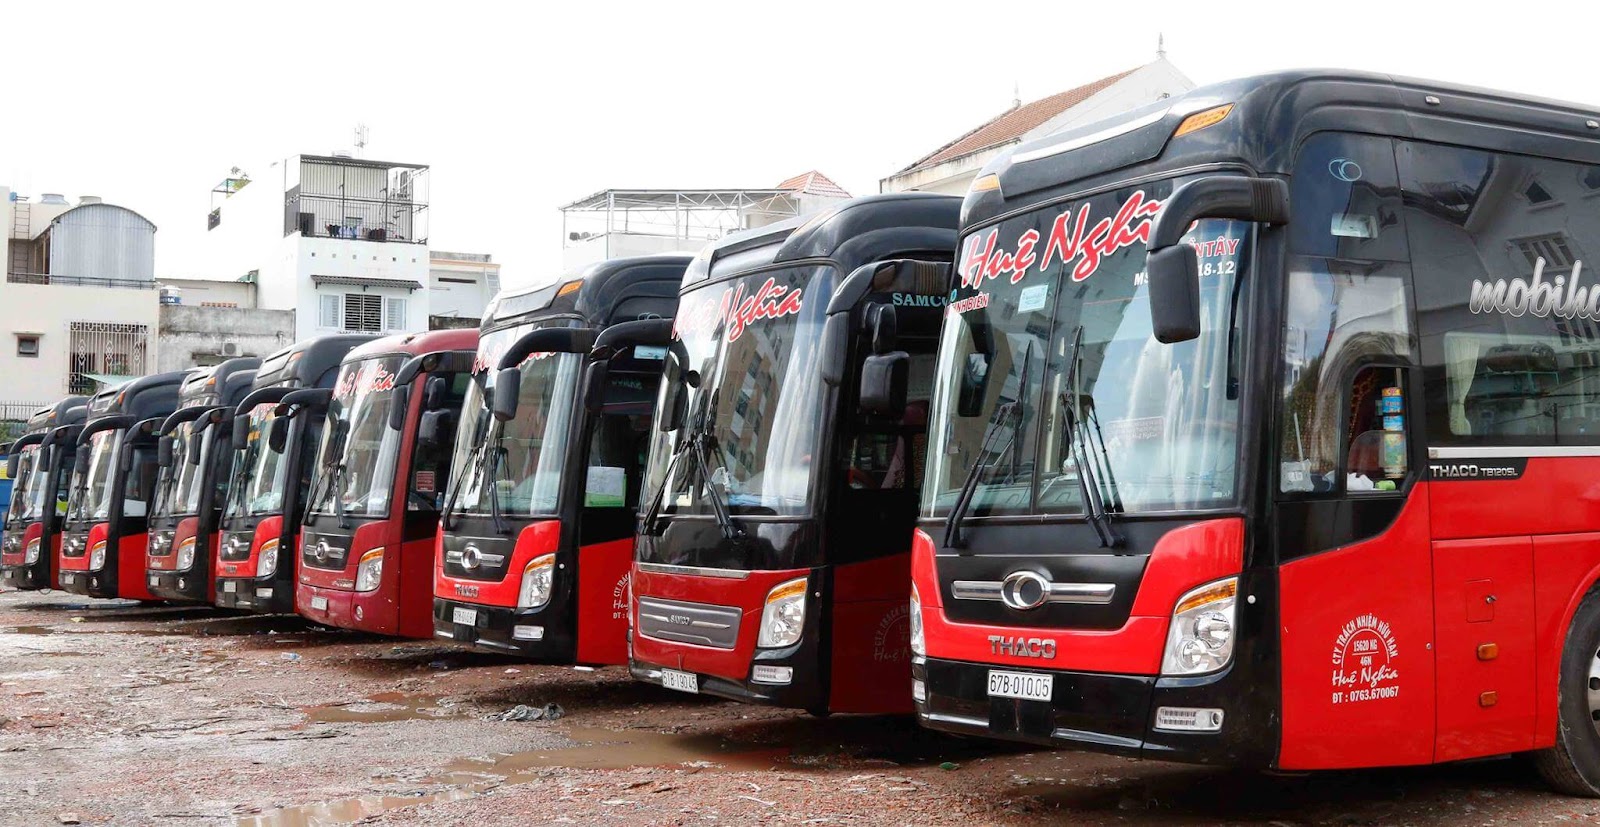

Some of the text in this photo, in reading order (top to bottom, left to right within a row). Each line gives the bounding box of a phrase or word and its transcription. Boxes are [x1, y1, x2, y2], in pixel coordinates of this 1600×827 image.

[960, 190, 1198, 290] Huệ Nghĩ
[713, 277, 802, 342] Nghĩa
[1429, 464, 1479, 478] THACO
[1356, 612, 1378, 630] NHIỆM
[1336, 620, 1357, 647] TRÁCH
[988, 635, 1057, 660] THACO
[1332, 646, 1342, 665] CTY
[989, 671, 1050, 698] 67B-010.05
[1332, 665, 1399, 688] Huệ Nghĩa
[1350, 686, 1400, 702] 0763.670067
